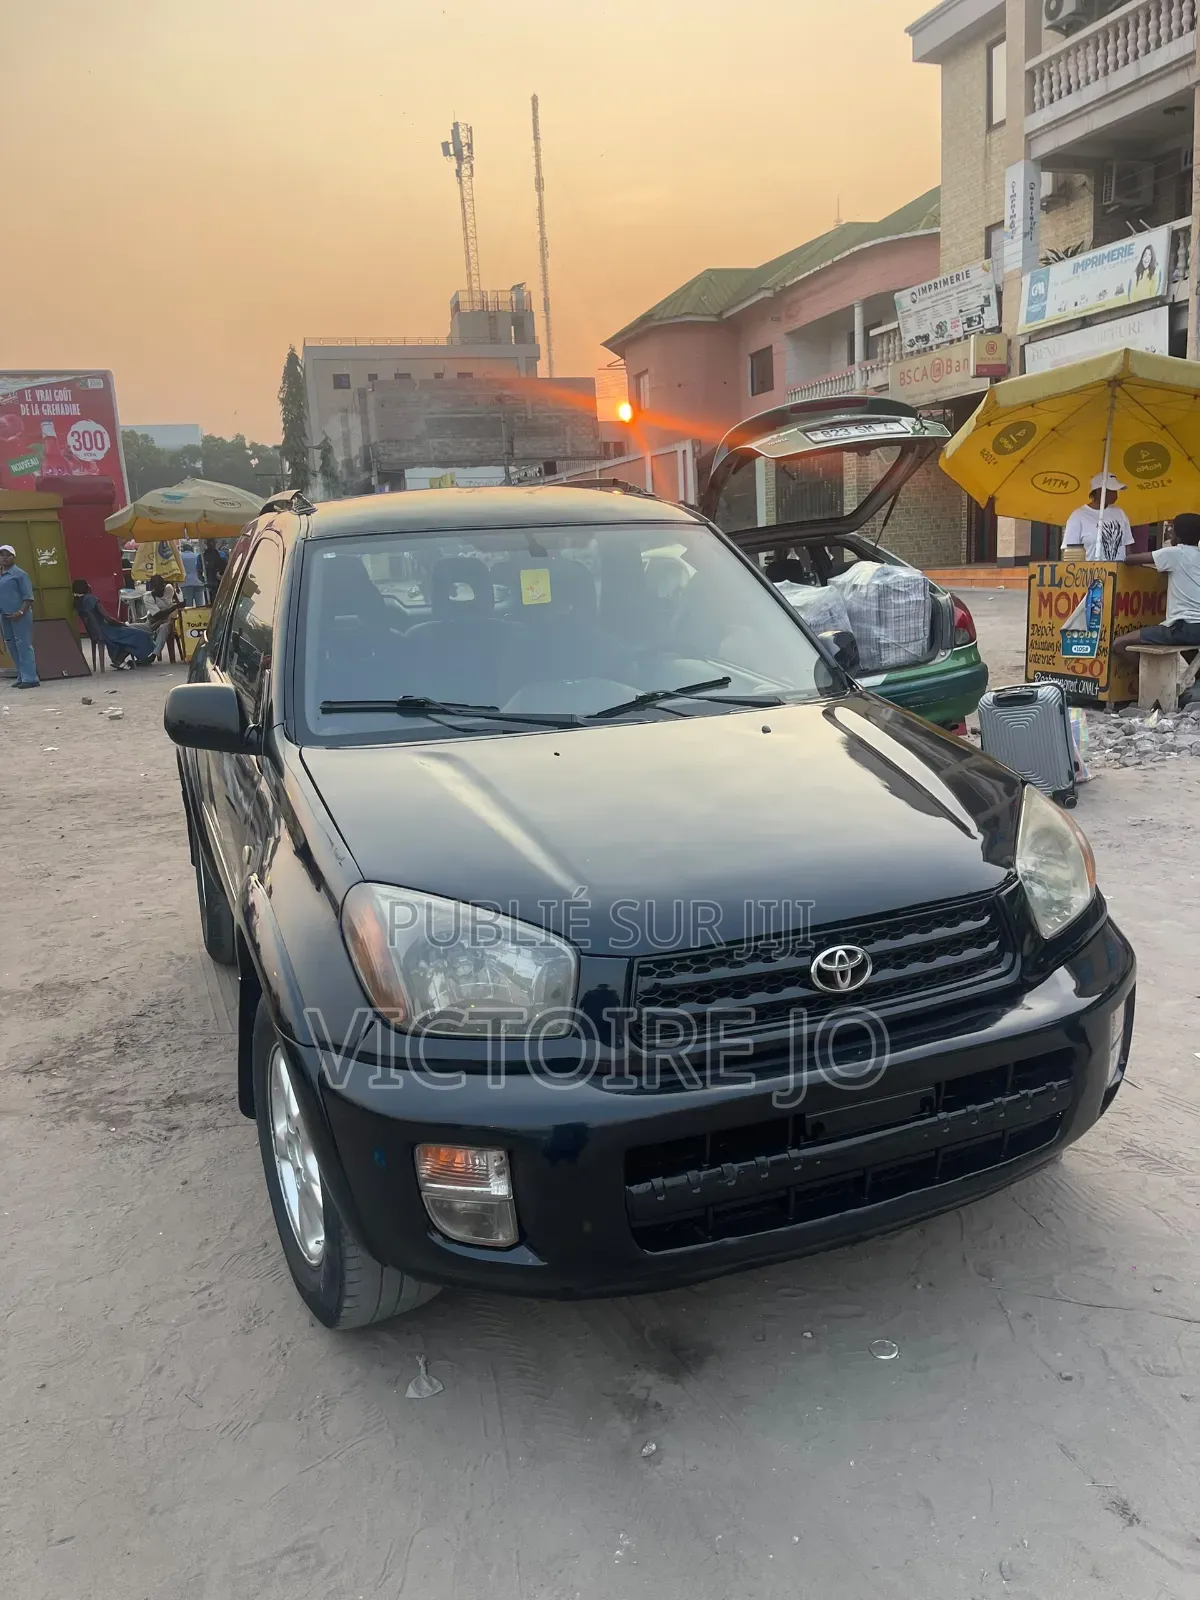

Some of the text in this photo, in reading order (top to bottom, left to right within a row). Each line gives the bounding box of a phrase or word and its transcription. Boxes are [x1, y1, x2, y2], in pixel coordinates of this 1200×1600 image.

[1072, 242, 1136, 275] IMPRIMERIE
[918, 269, 971, 297] IMPRIMERIE
[899, 358, 969, 387] BSCA Ban
[24, 389, 33, 402] LE
[35, 389, 53, 402] VRAI
[53, 387, 72, 402] GOÛT
[20, 403, 81, 416] DE LA GRENADINE
[820, 427, 851, 439] 823
[857, 424, 875, 434] SM
[10, 457, 40, 473] NOUVEAU
[1036, 564, 1063, 589] IL
